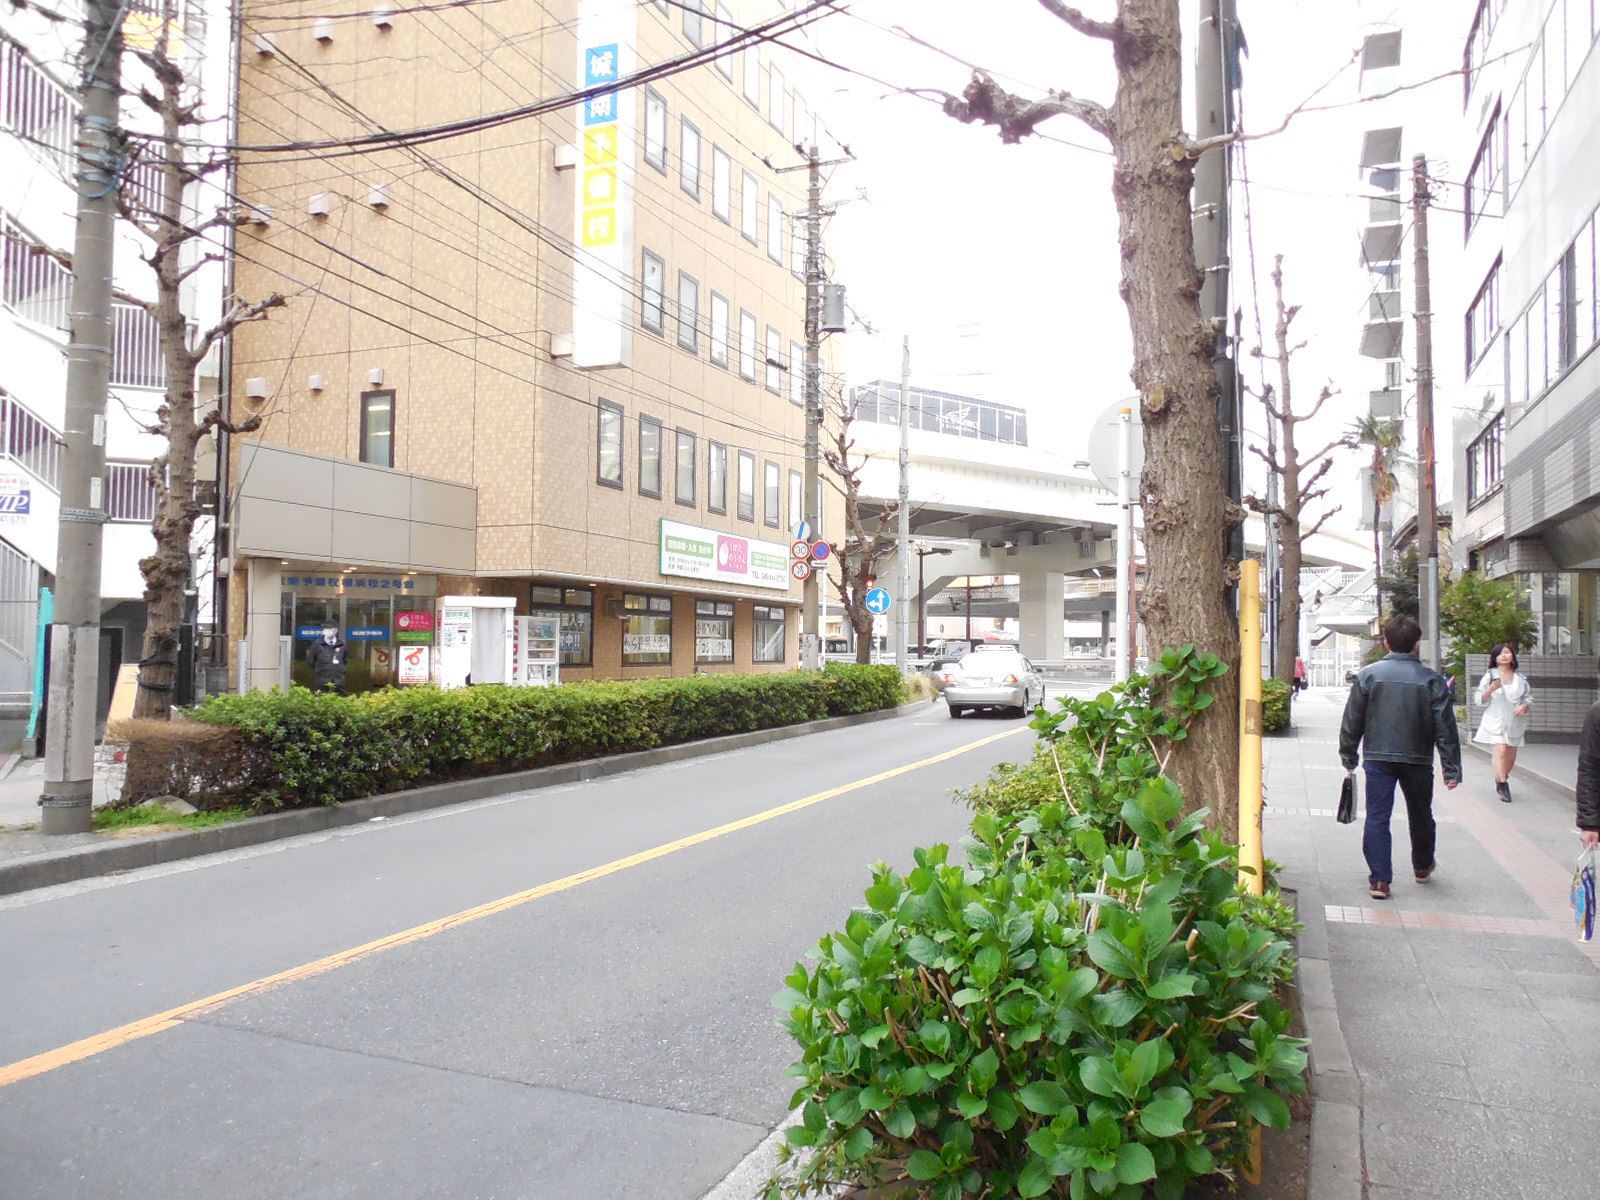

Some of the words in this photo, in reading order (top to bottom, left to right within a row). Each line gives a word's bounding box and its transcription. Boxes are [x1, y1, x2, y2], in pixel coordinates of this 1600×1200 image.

[588, 51, 613, 239] 城南予校
[796, 546, 806, 555] 30
